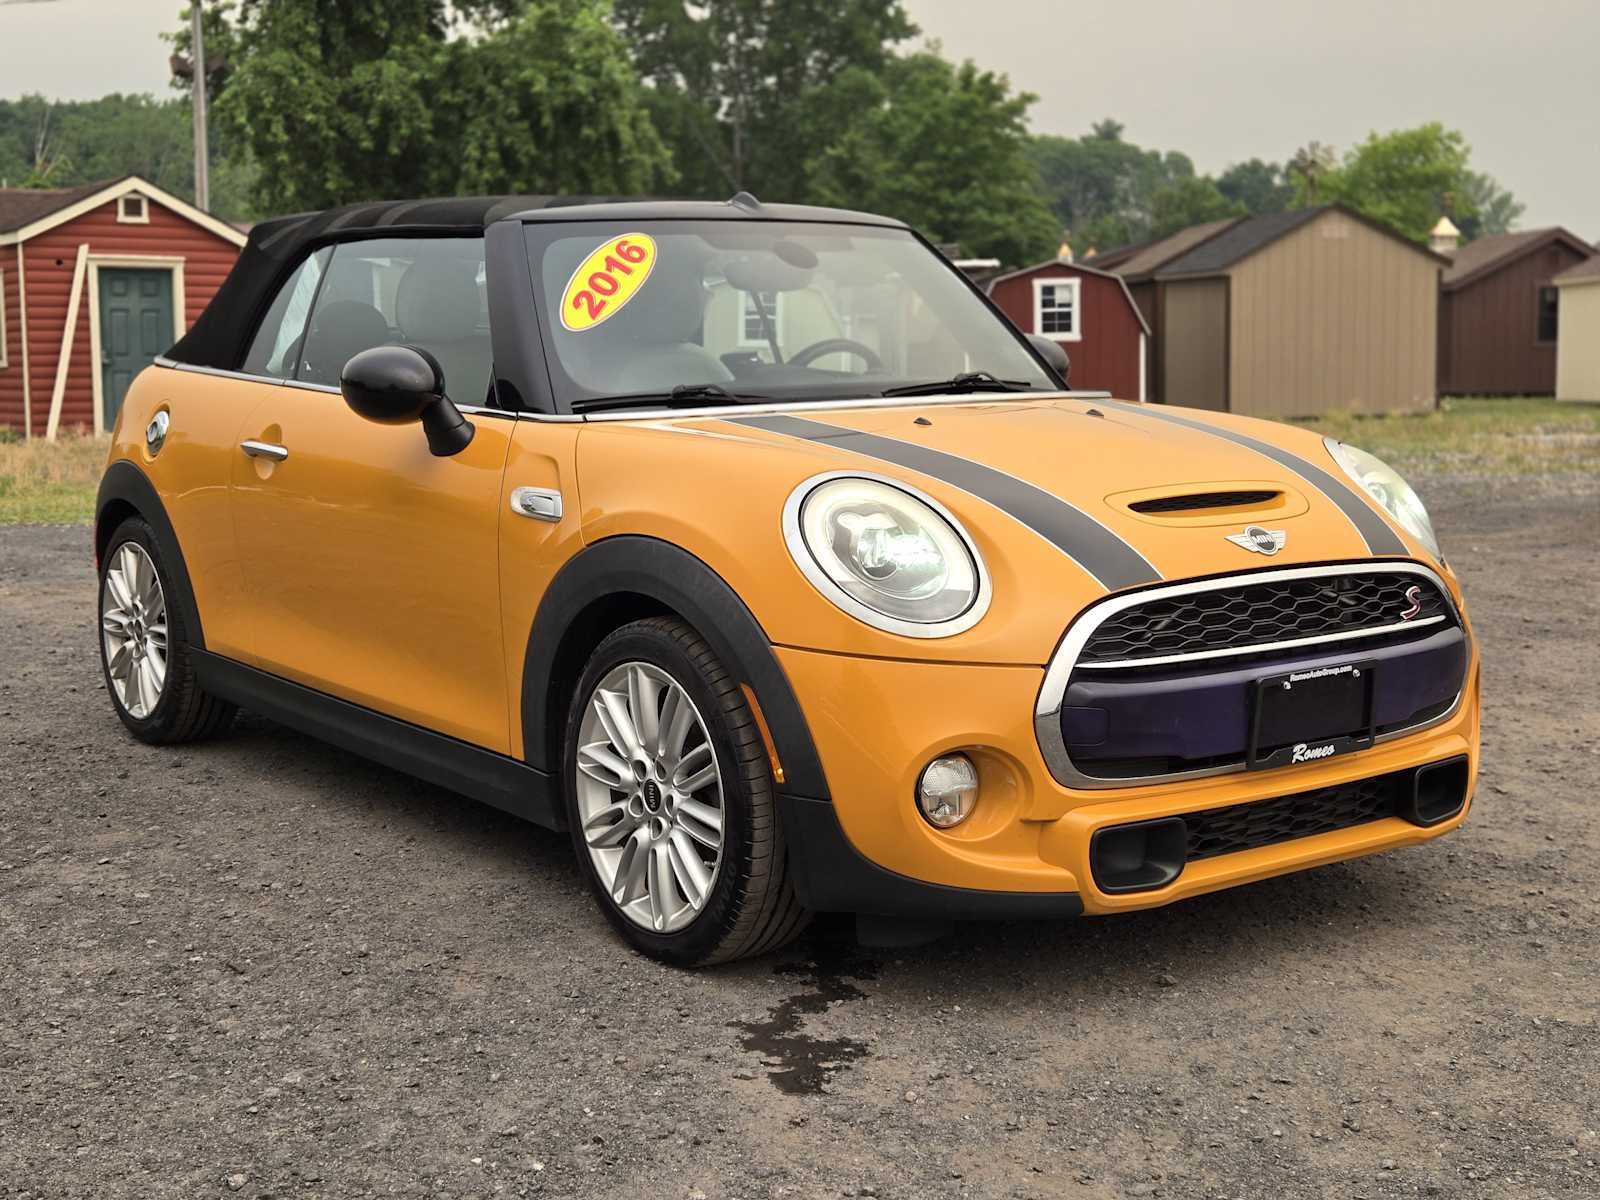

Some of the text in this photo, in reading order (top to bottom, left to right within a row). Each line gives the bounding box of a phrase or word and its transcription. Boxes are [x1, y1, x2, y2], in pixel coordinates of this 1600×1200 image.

[572, 240, 646, 321] 2016
[1252, 534, 1274, 545] MINI
[1291, 743, 1335, 764] Romeo
[648, 783, 656, 809] MINI
